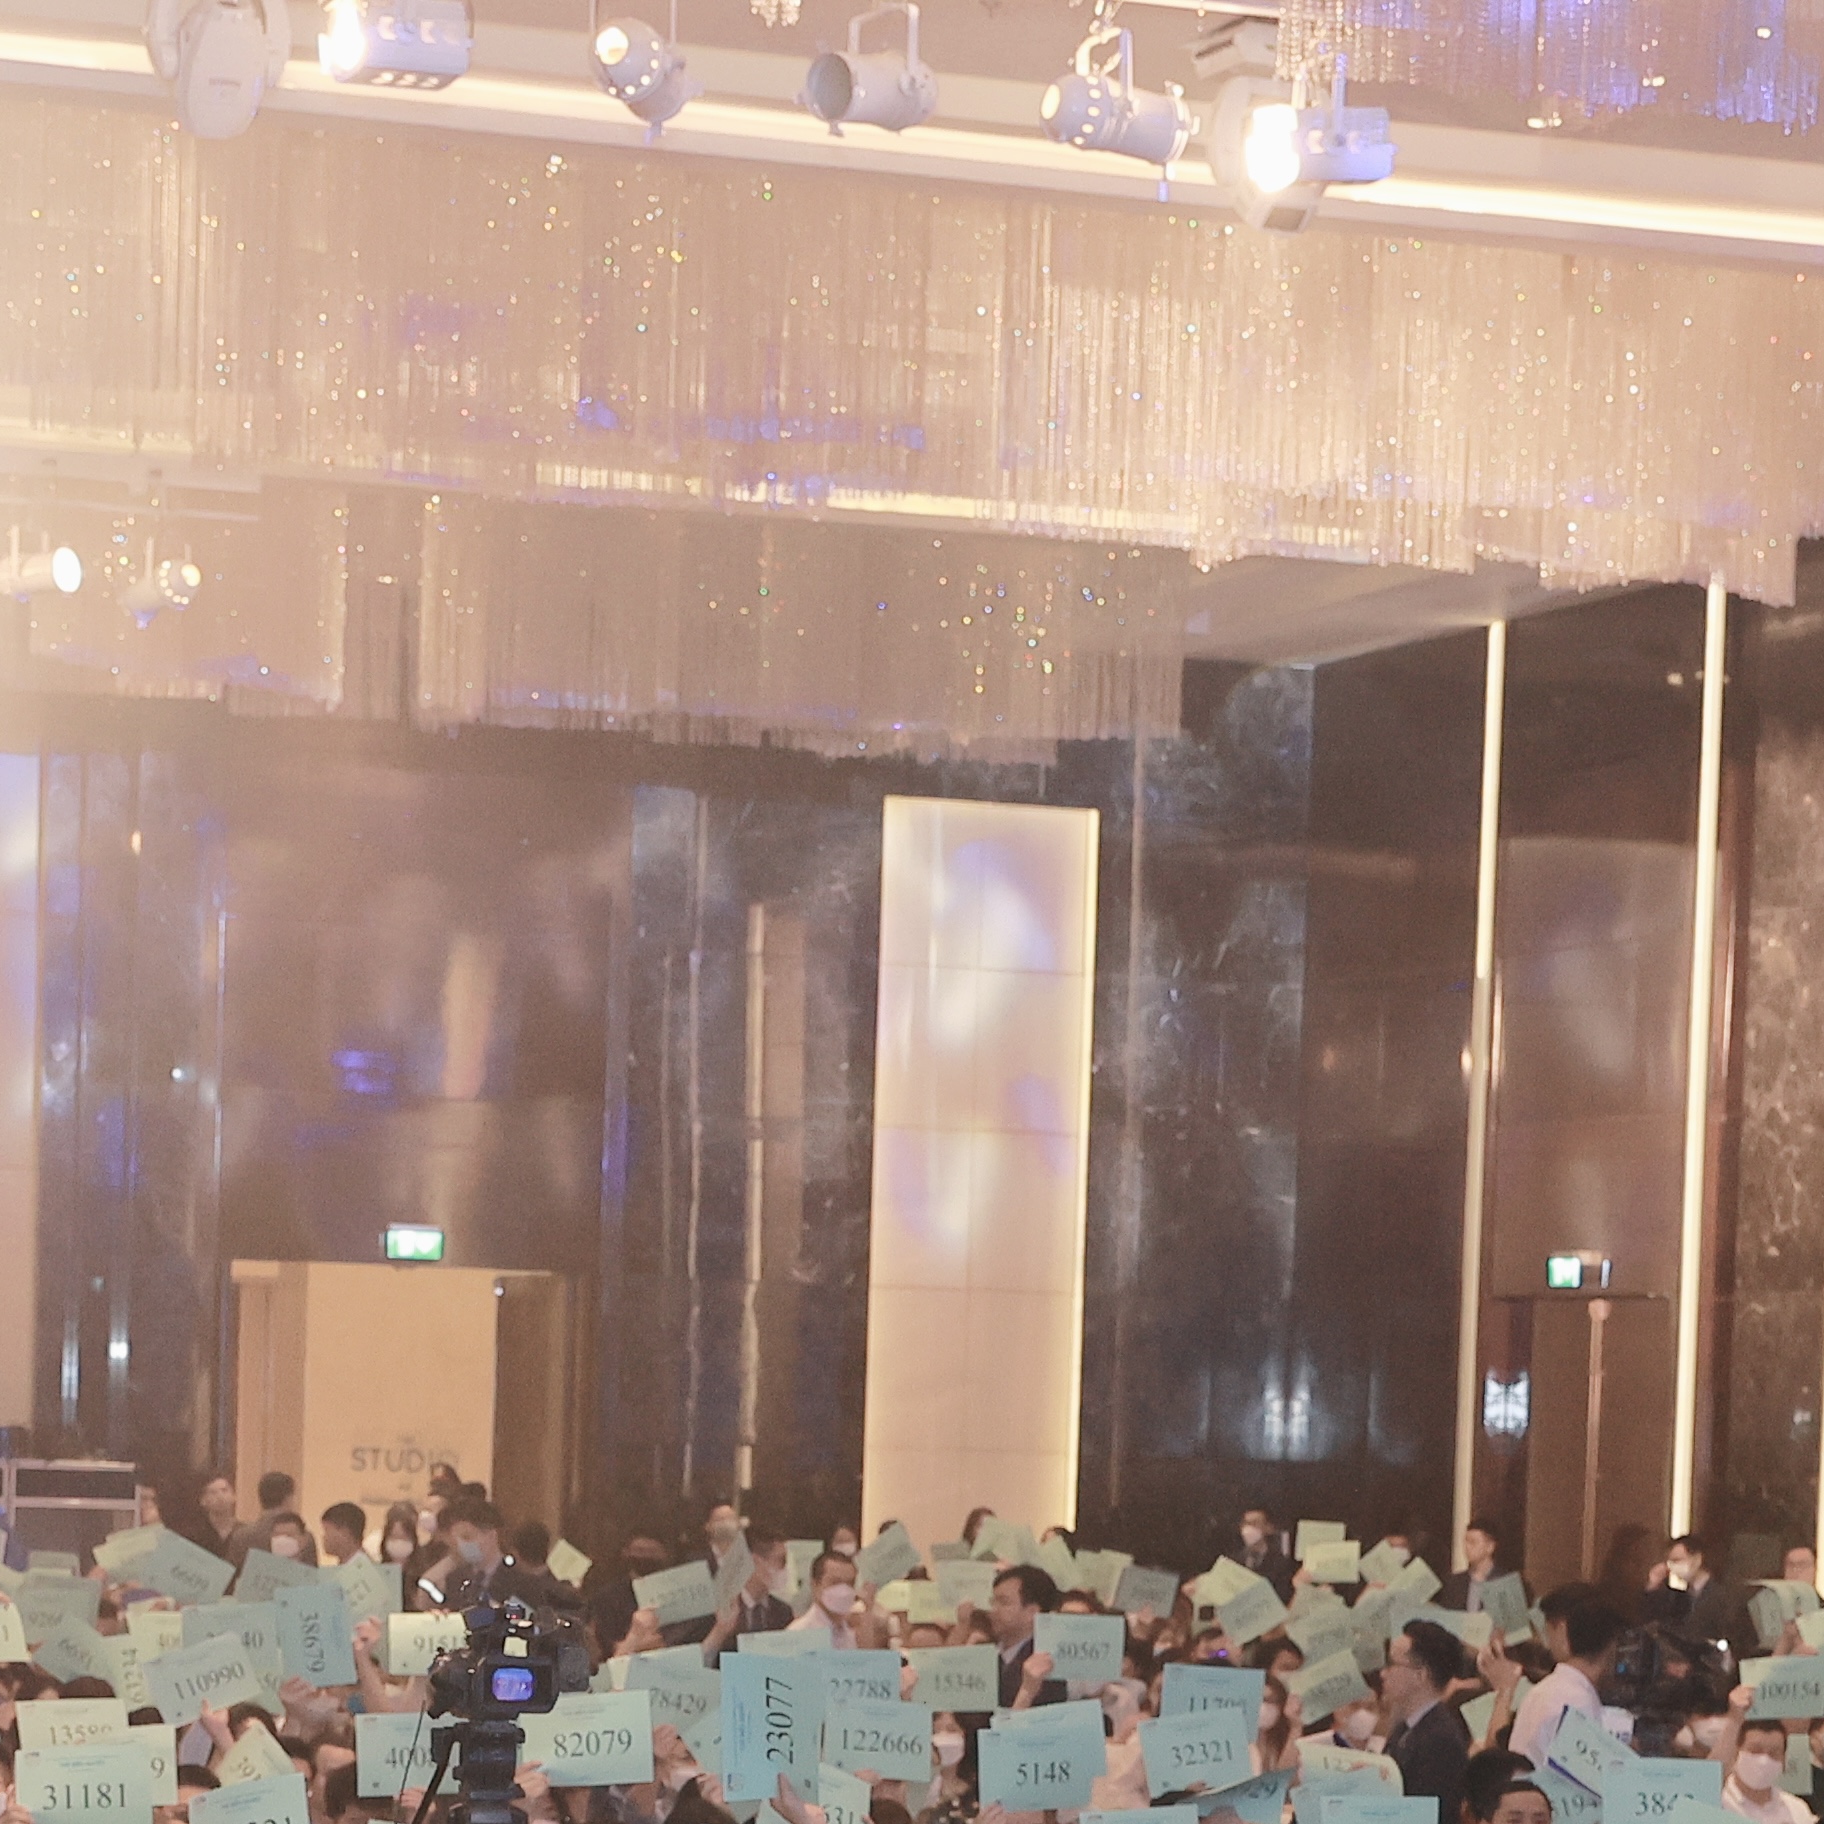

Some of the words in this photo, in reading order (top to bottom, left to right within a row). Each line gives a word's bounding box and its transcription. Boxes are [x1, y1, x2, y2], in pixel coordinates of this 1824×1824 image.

[350, 1446, 461, 1475] STUDIO
[299, 1612, 325, 1673] 38679
[174, 1662, 245, 1700] 110990
[765, 1677, 793, 1764] 23077
[554, 1729, 632, 1757] 82079
[843, 1728, 923, 1754] 122666
[1172, 1740, 1232, 1767] 32321
[1017, 1761, 1070, 1786] 5148
[43, 1783, 125, 1810] 31181
